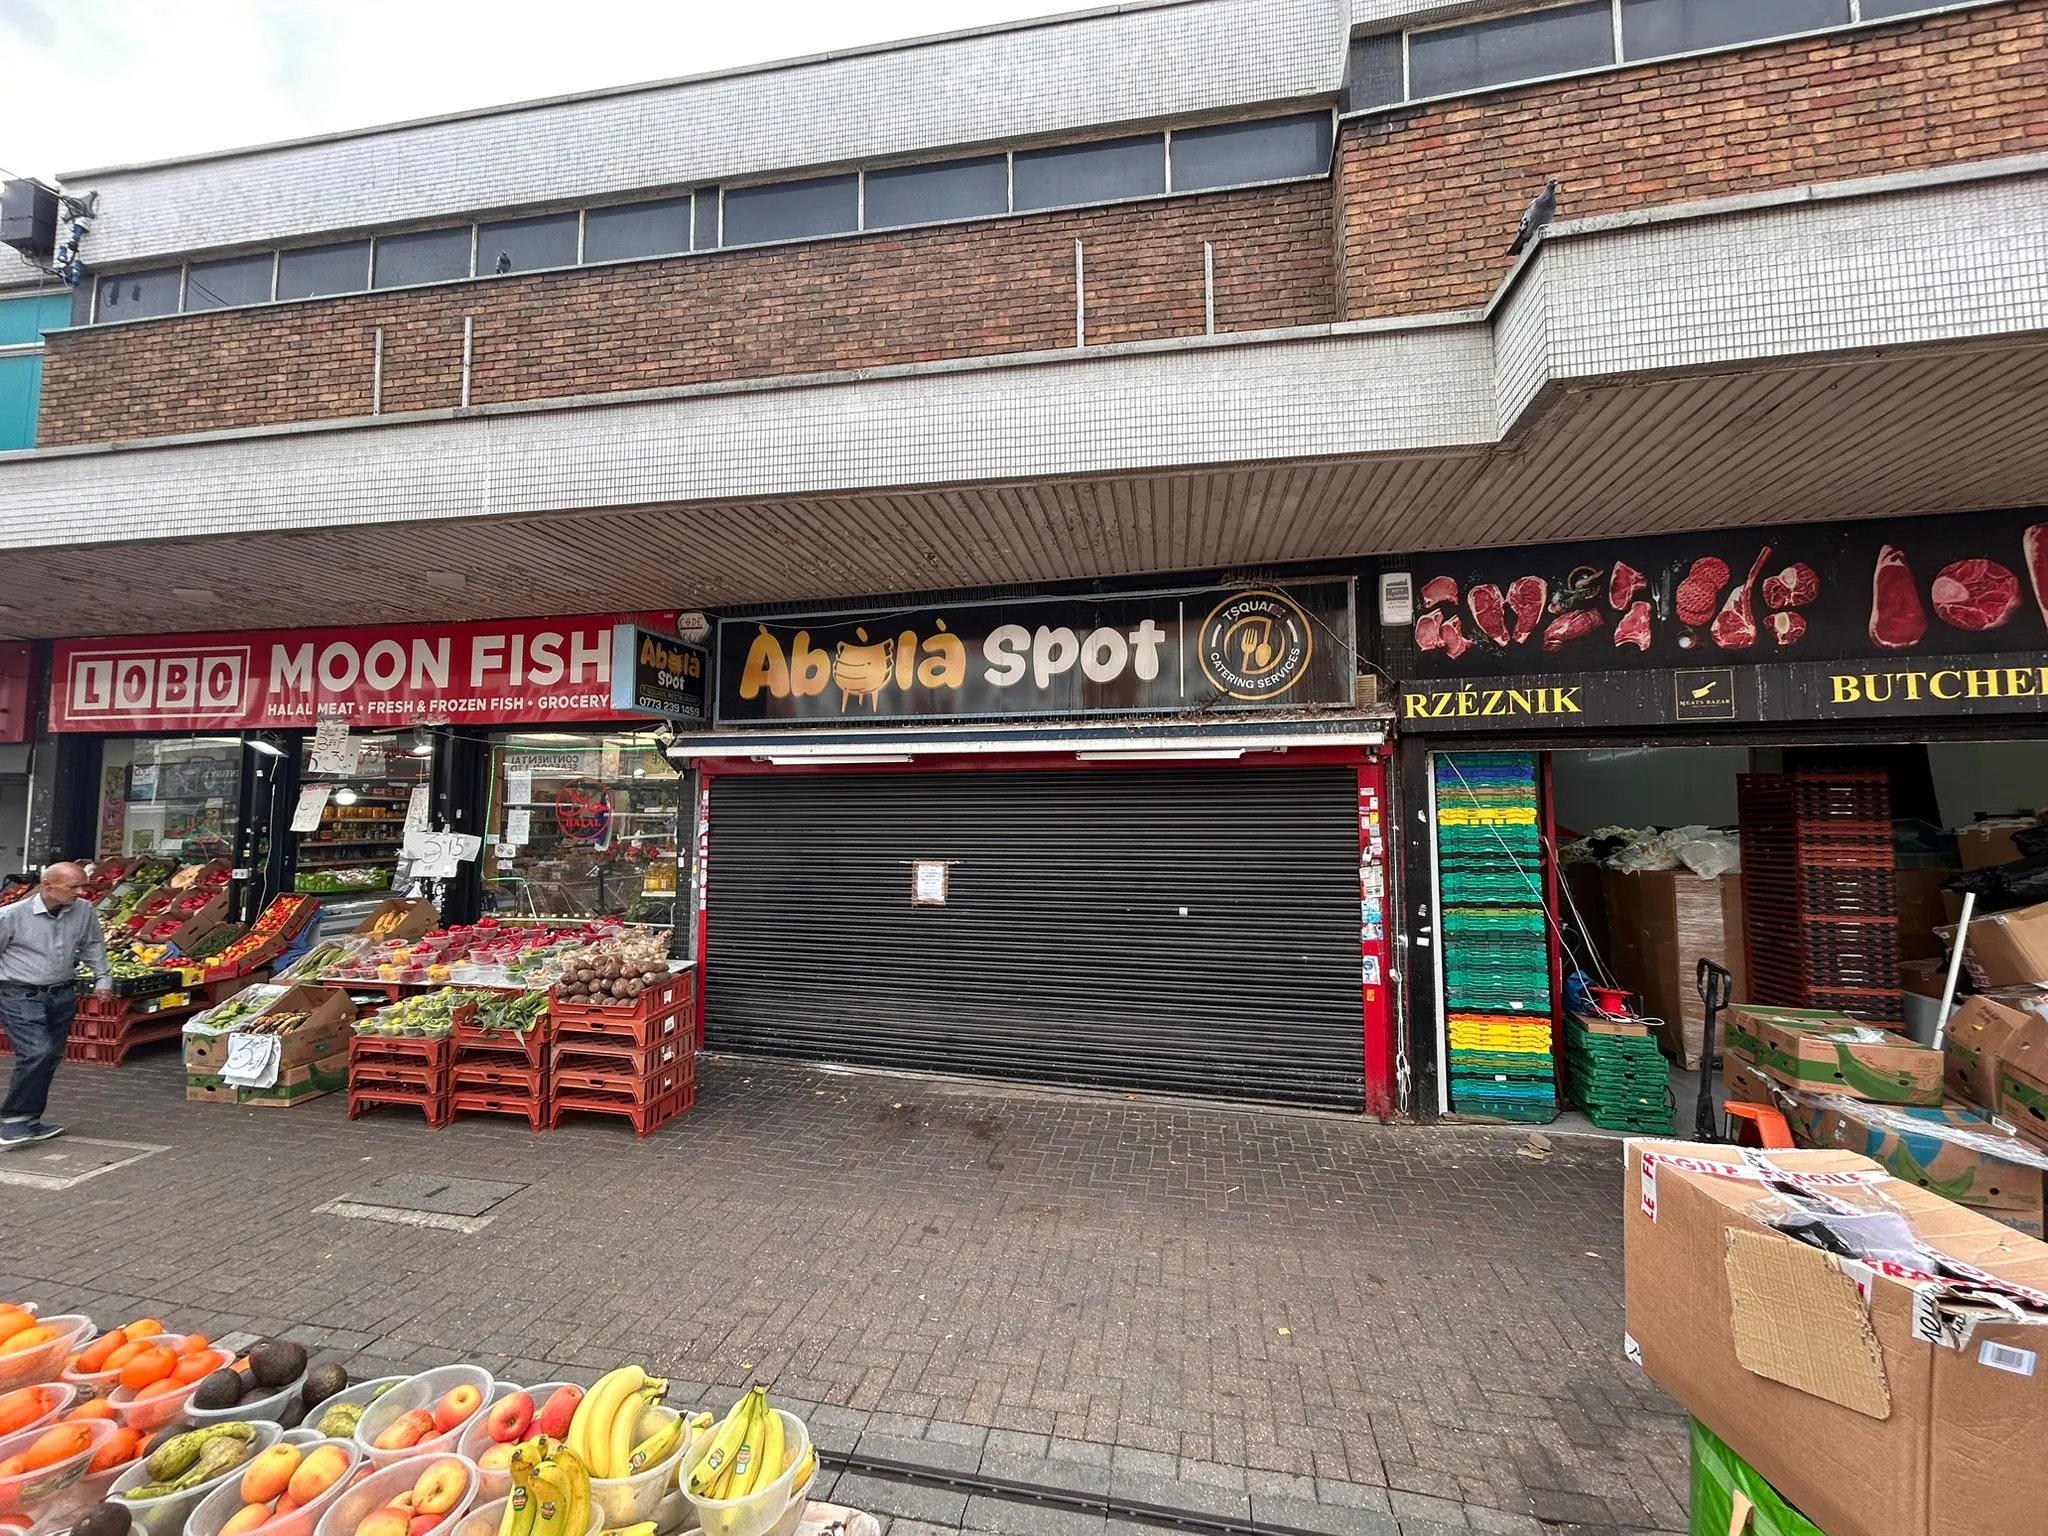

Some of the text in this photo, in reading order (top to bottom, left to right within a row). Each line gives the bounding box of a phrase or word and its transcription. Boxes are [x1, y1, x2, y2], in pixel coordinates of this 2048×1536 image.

[1221, 600, 1287, 621] TSQUA
[269, 629, 612, 693] MOON FISH
[1210, 647, 1301, 689] CATERING SERVICES
[82, 660, 234, 705] LOBO
[267, 694, 610, 716] HALAL MEAT FRESH & FROZEN FISH GROCERY
[639, 696, 700, 717] 0773 239 1459
[1402, 683, 1583, 719] RZÉZNIK
[565, 818, 602, 828] HALAL
